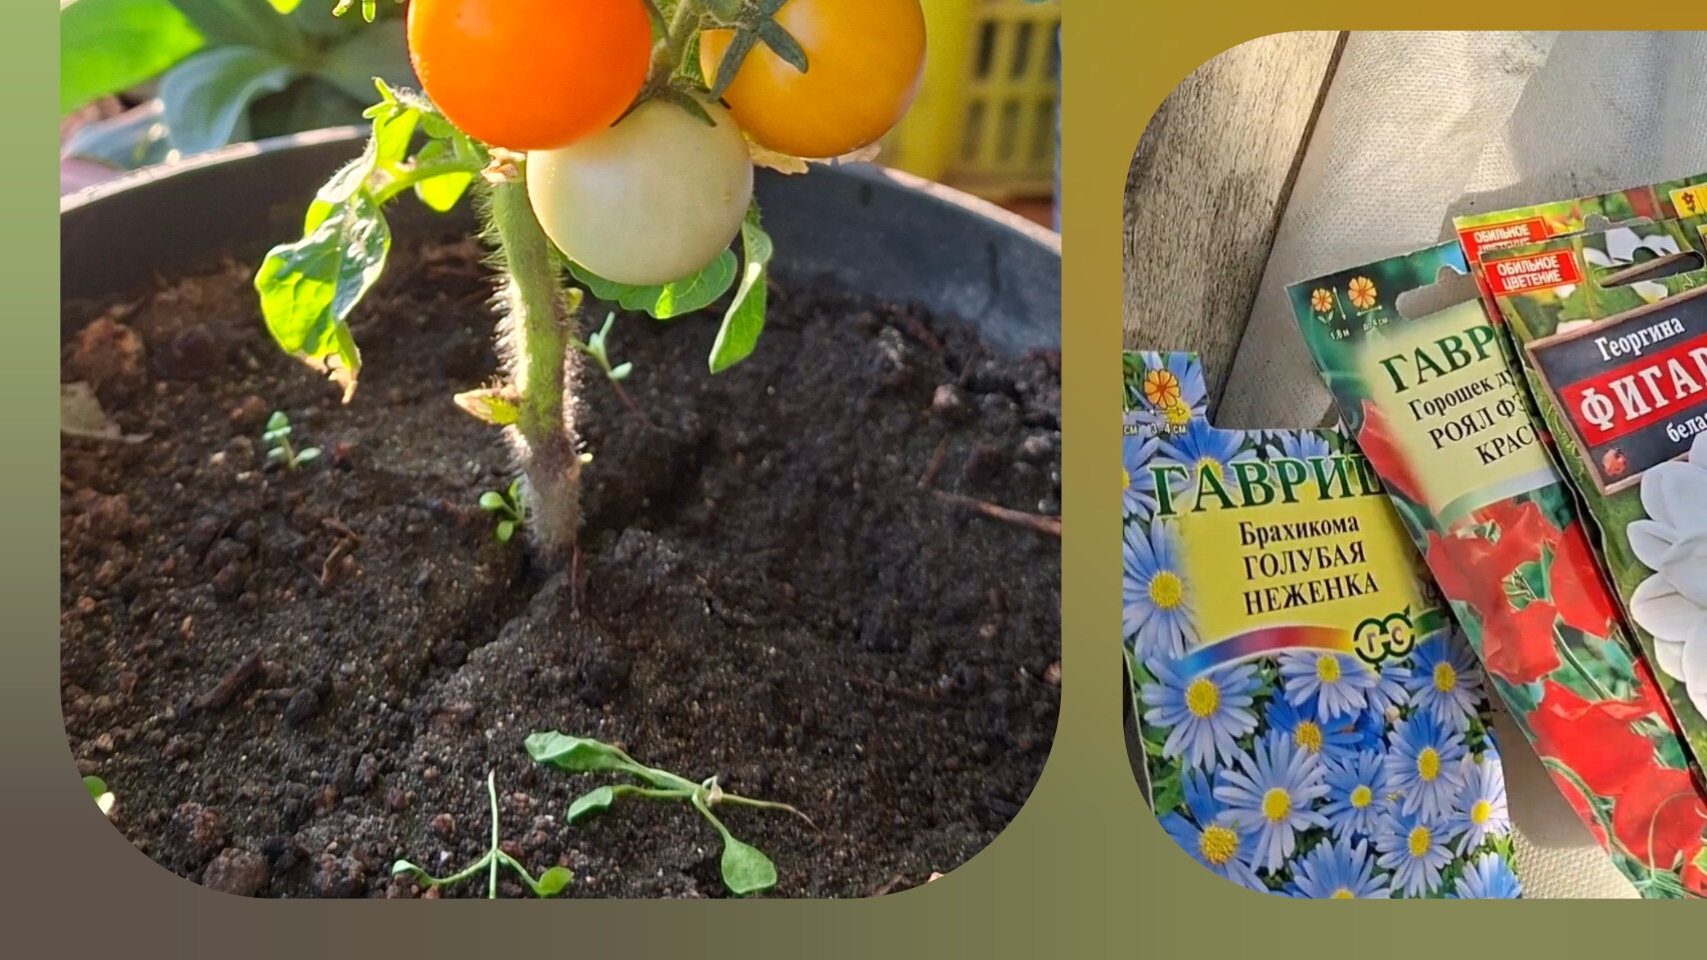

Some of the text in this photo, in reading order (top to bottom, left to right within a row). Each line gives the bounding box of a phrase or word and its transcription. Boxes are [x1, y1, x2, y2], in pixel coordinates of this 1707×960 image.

[1474, 224, 1530, 243] ОБИЛЬНОЕ
[1497, 255, 1560, 276] ОБИЛЬНОЕ
[1502, 269, 1562, 291] ЦВЕТЕНИЕ
[1379, 325, 1494, 394] ГАВР
[1594, 317, 1686, 362] Георгина
[1408, 376, 1494, 422] Горошек
[1427, 406, 1496, 451] РОЯЛ
[1238, 515, 1360, 549] Брахикома
[1243, 541, 1367, 581] ГОЛУБАЯ
[1244, 571, 1380, 616] НЕЖЕНКА
